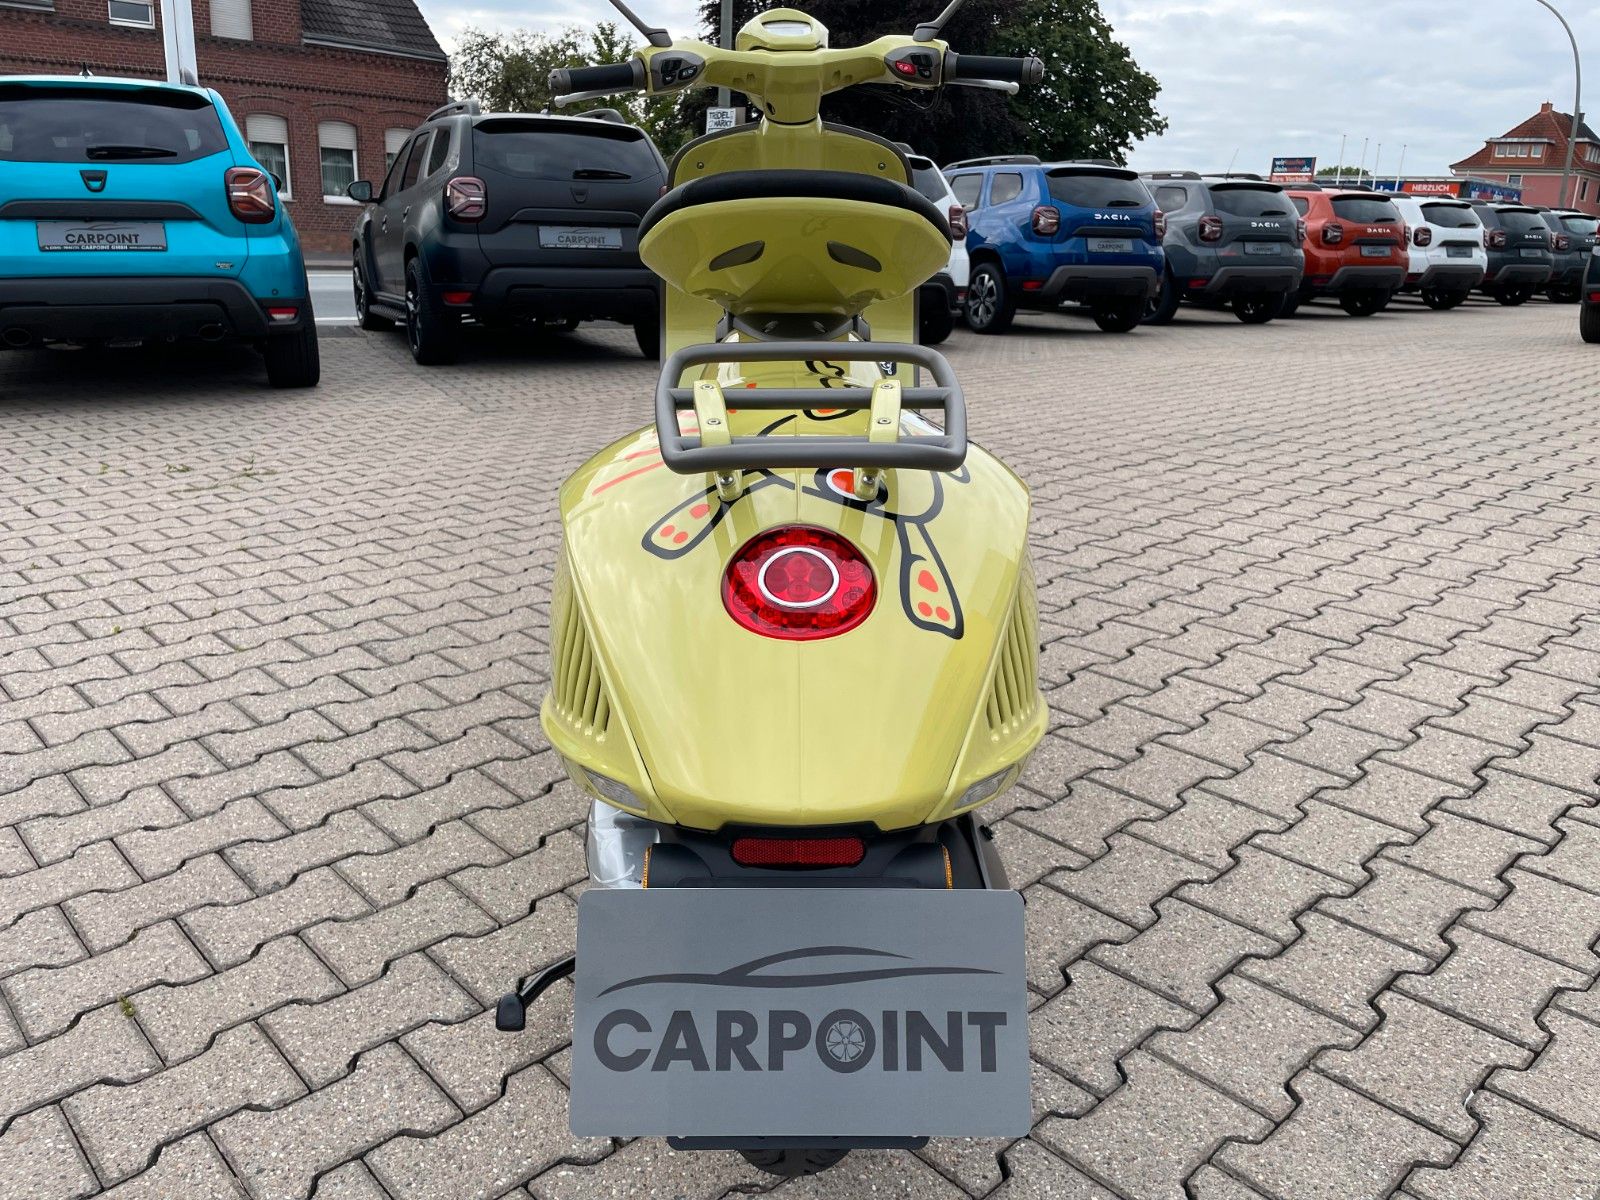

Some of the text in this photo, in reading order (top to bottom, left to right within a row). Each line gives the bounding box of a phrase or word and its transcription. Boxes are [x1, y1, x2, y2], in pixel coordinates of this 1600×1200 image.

[1412, 183, 1450, 192] HERZLICH
[65, 233, 140, 244] CARPOINT
[557, 235, 606, 244] CARPOINT
[593, 1008, 1008, 1074] CARPOINT
